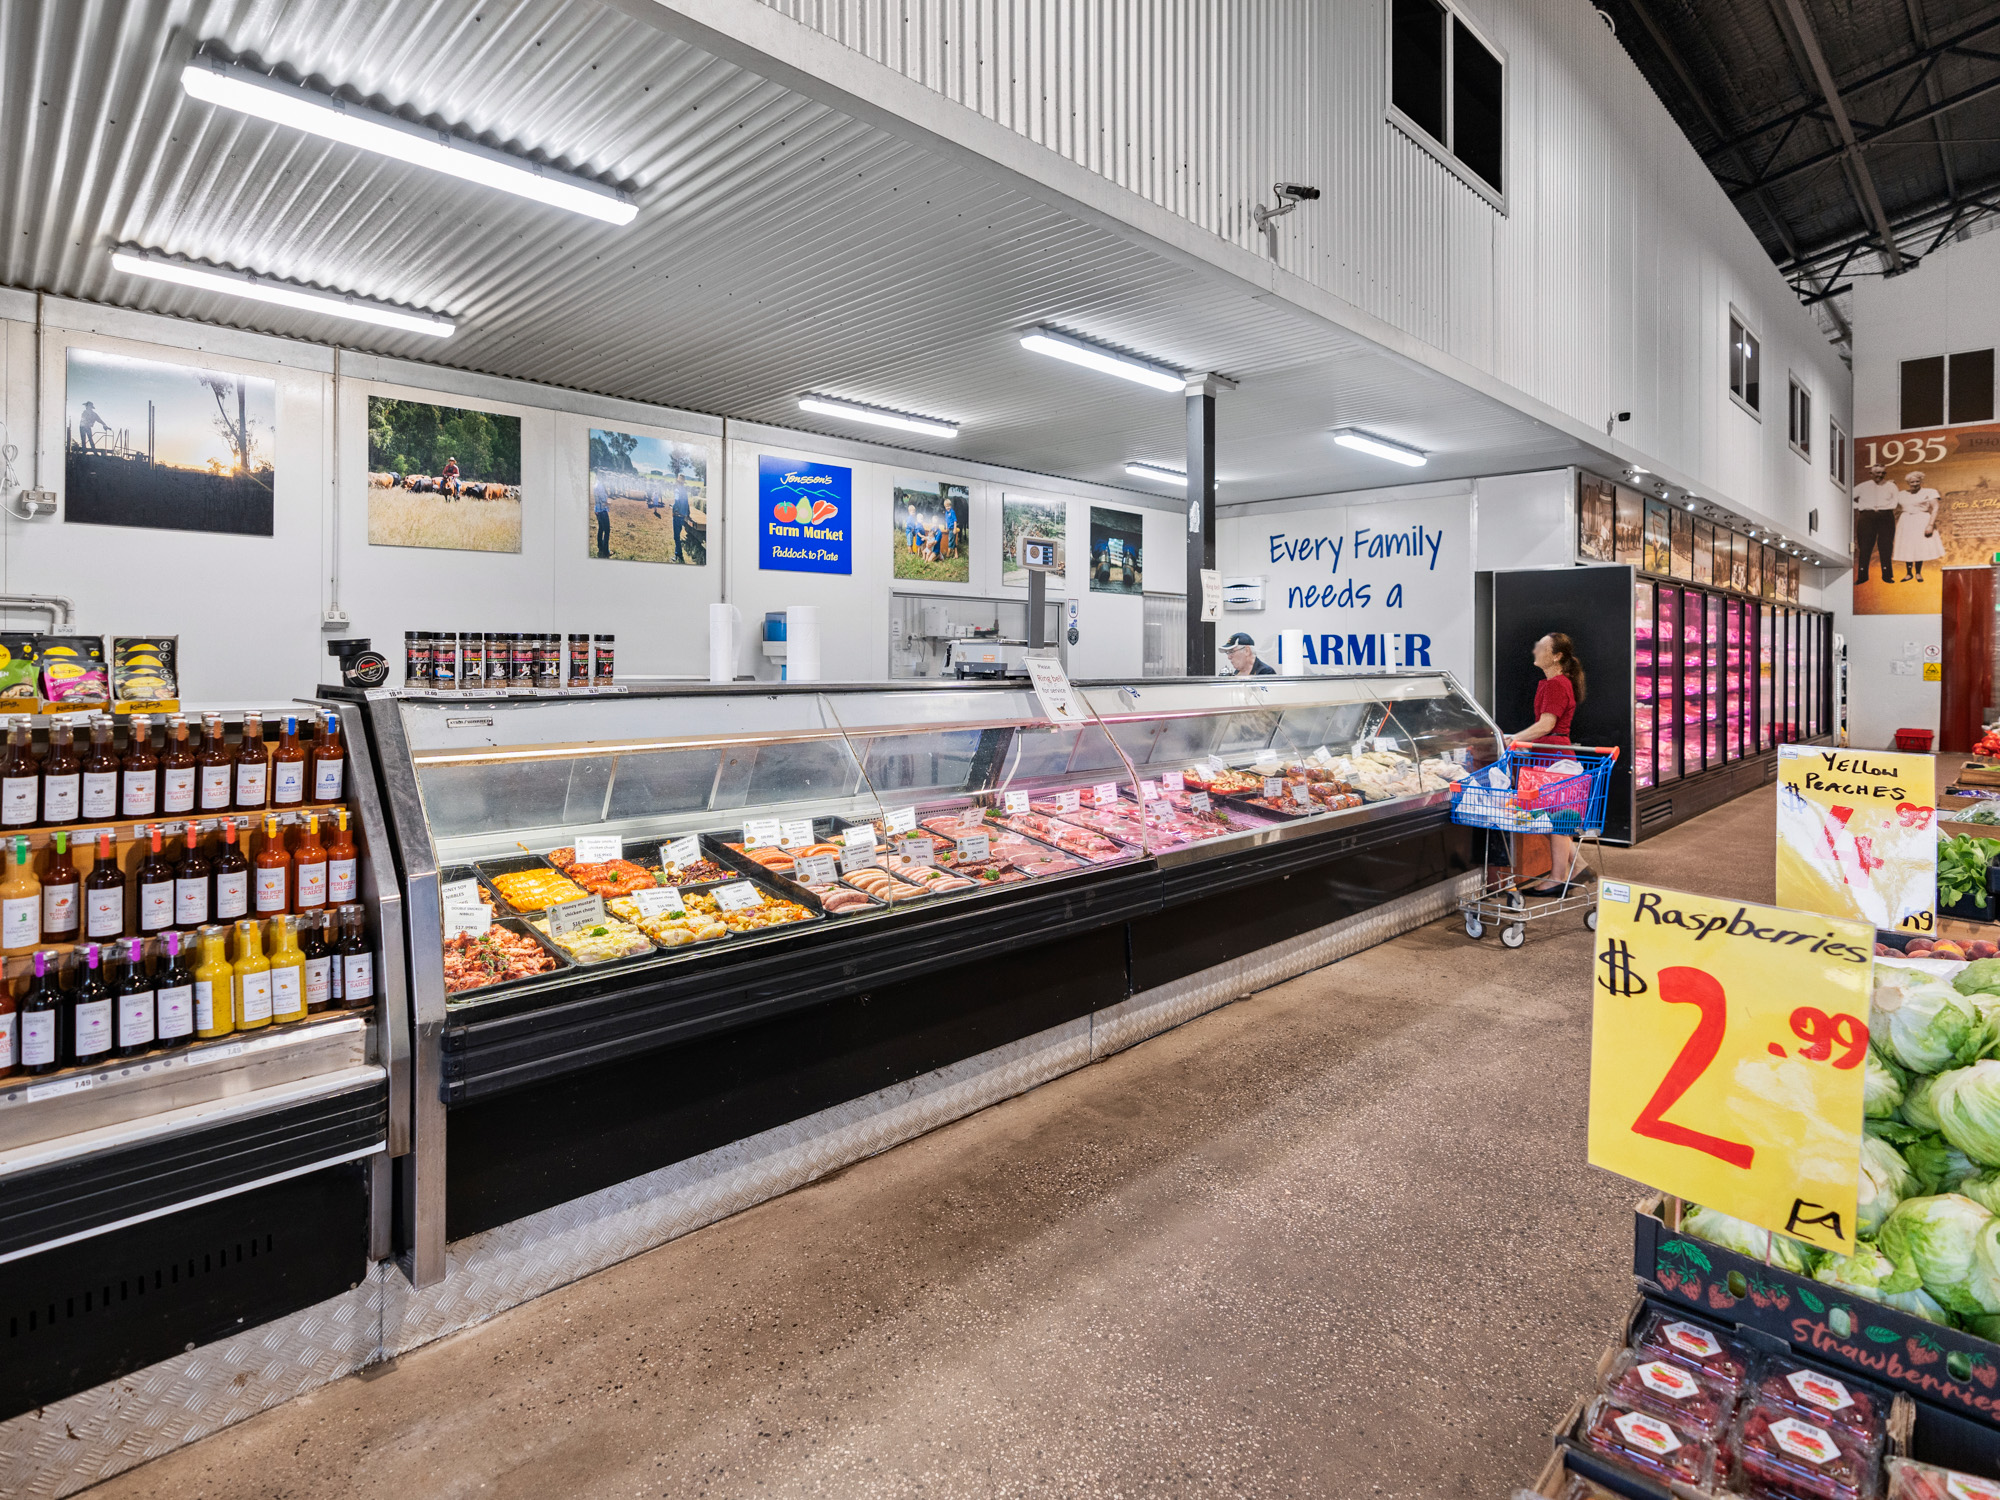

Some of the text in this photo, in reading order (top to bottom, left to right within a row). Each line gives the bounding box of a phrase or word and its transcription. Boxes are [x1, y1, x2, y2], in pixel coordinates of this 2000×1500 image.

[1864, 436, 1947, 468] 1935
[780, 471, 832, 484] Jonsson's
[769, 522, 843, 541] Farm Market
[772, 545, 838, 561] Paddock to Plate
[1269, 525, 1442, 573] Every Family
[1288, 578, 1403, 608] needs a
[1278, 633, 1431, 666] ARMER
[1037, 674, 1063, 684] Ring bell
[578, 899, 596, 907] mustard
[582, 906, 596, 914] chops
[1633, 892, 1868, 963] Raspberries
[307, 984, 328, 992] SAUCE
[350, 980, 371, 988] SAUCE
[75, 1080, 91, 1088] 7.49
